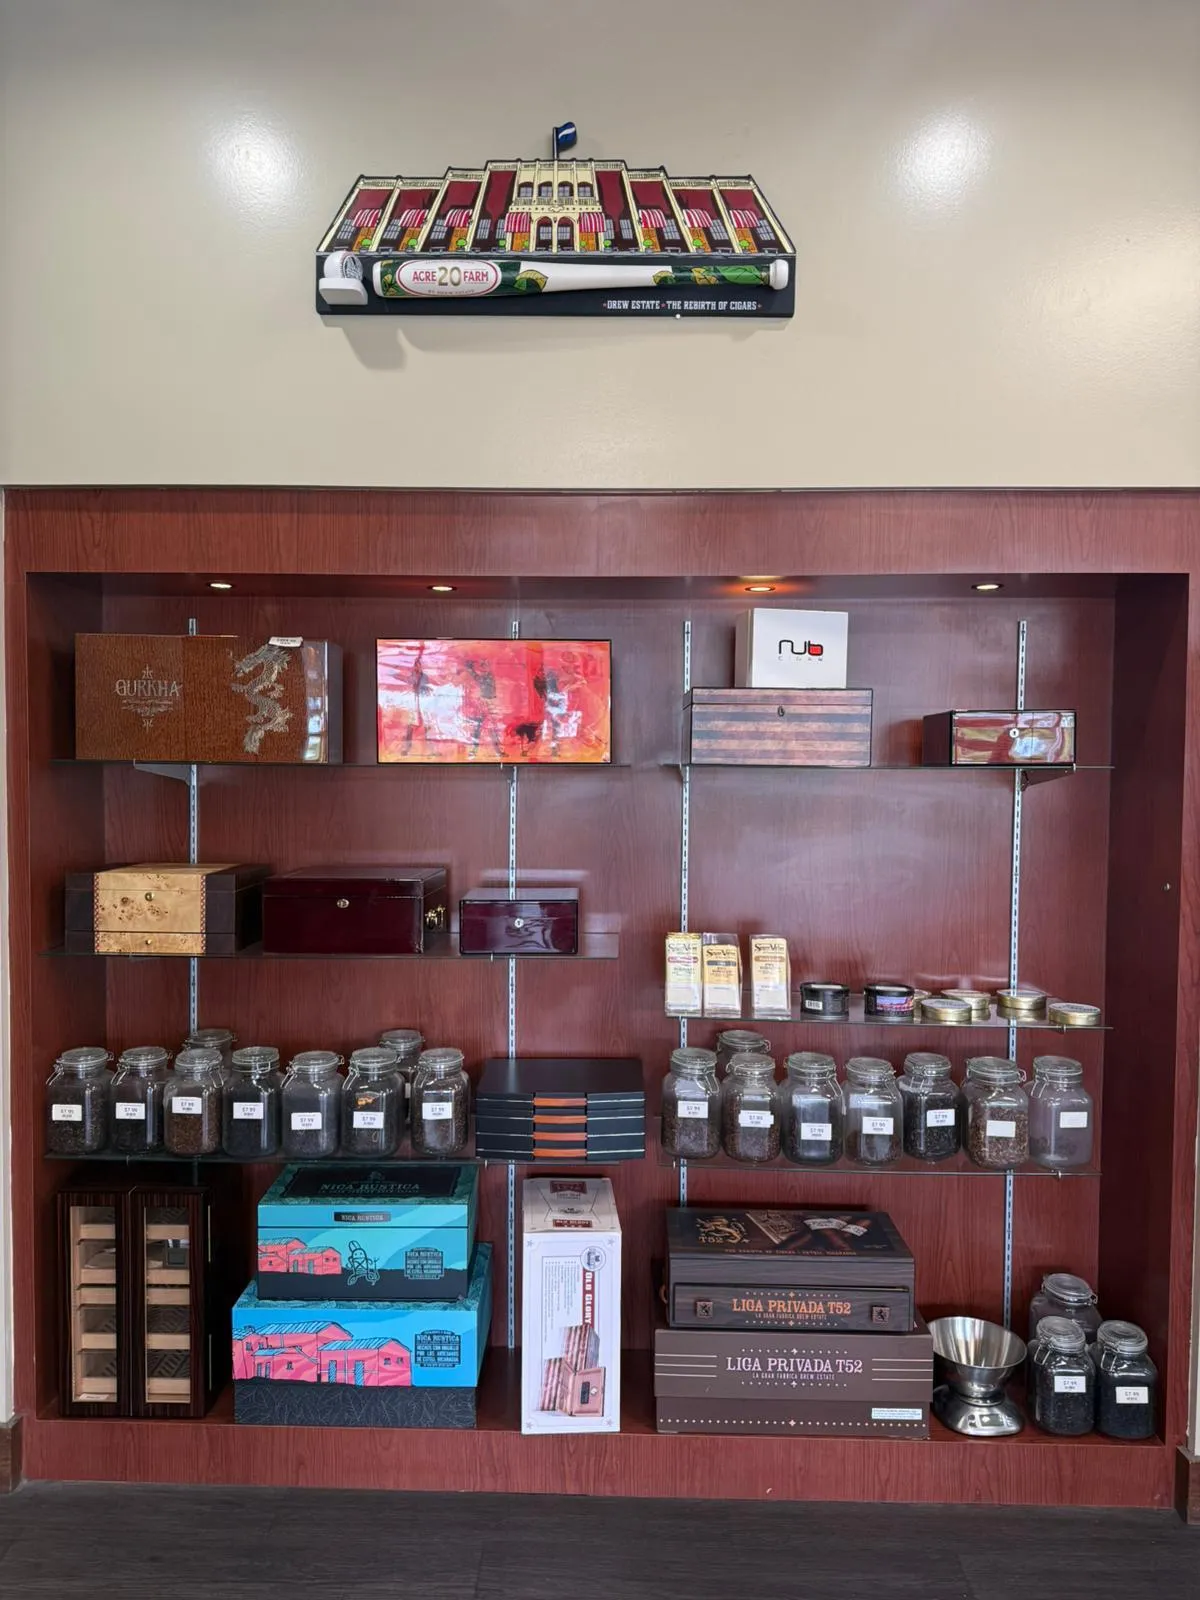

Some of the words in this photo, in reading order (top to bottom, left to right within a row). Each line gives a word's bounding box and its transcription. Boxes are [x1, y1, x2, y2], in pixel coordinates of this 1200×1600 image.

[412, 271, 437, 282] ACRE
[437, 266, 462, 287] 20
[463, 271, 489, 282] FARM
[607, 300, 630, 310] DREW
[631, 300, 660, 310] ESTATE
[666, 300, 682, 310] THE
[683, 301, 716, 311] REBIRTH
[718, 301, 728, 311] OF
[729, 301, 757, 311] CIGARS
[778, 639, 824, 657] nub
[113, 679, 183, 697] GURKHA
[585, 1271, 593, 1291] OLD
[584, 1293, 593, 1324] GLORY
[732, 1298, 764, 1312] LIGA
[767, 1299, 826, 1314] PRIVADA
[827, 1301, 852, 1315] T52
[726, 1357, 762, 1371] LIGA
[767, 1357, 833, 1373] PRIVADA
[835, 1359, 863, 1373] T52
